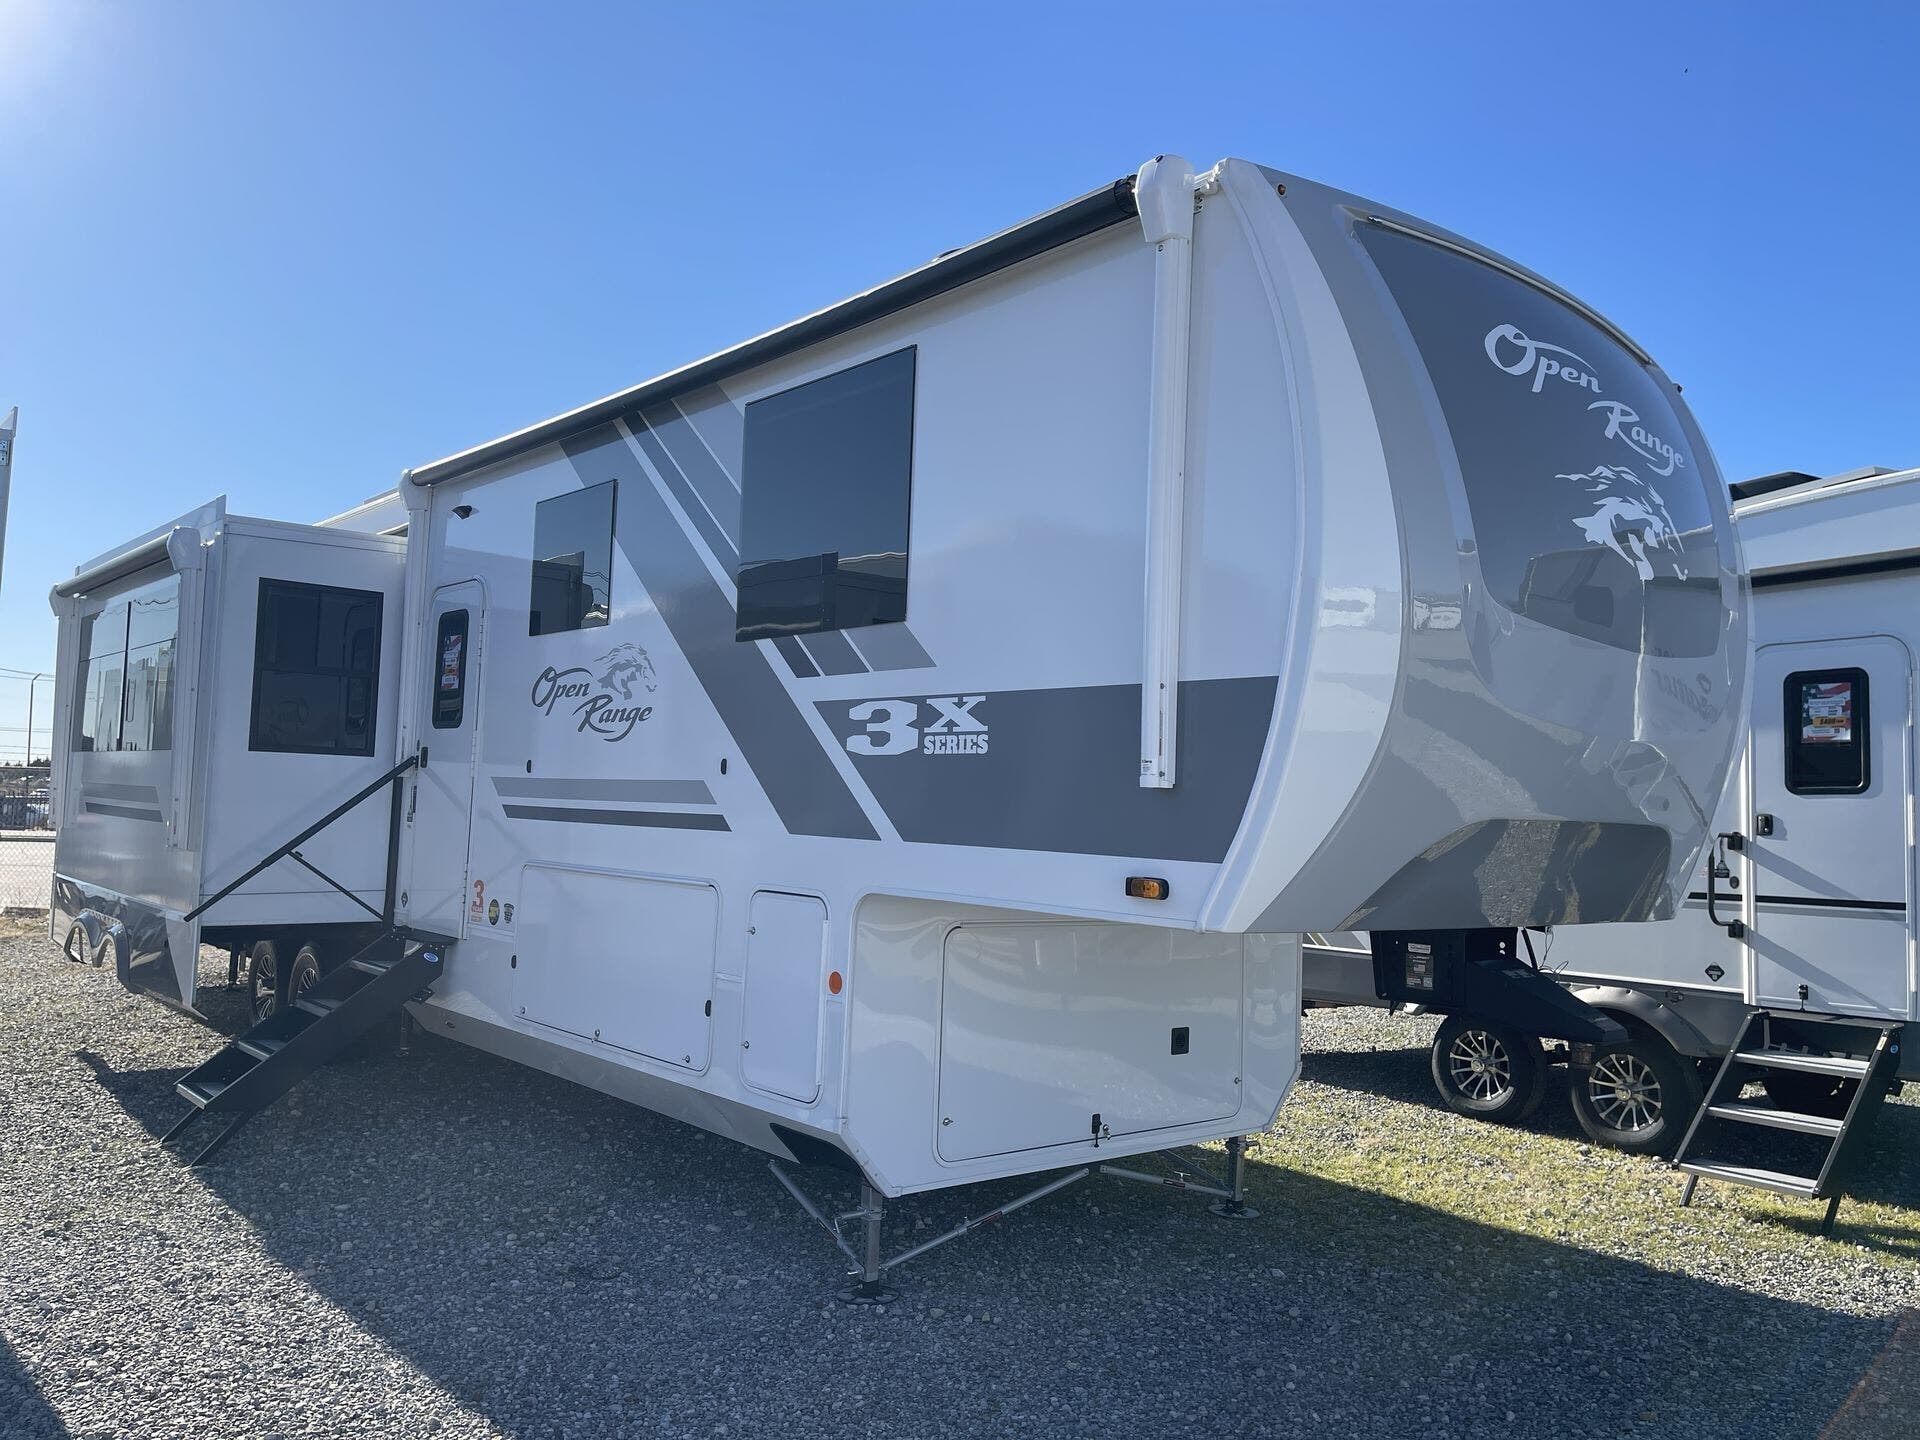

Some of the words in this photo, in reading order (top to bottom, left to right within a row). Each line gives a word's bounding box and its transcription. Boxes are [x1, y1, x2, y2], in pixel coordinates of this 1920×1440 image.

[1484, 323, 1602, 393] Open
[1587, 400, 1686, 477] Range
[531, 666, 594, 717] Open
[572, 694, 653, 742] Range
[923, 733, 989, 755] SERIES
[473, 879, 485, 907] 3
